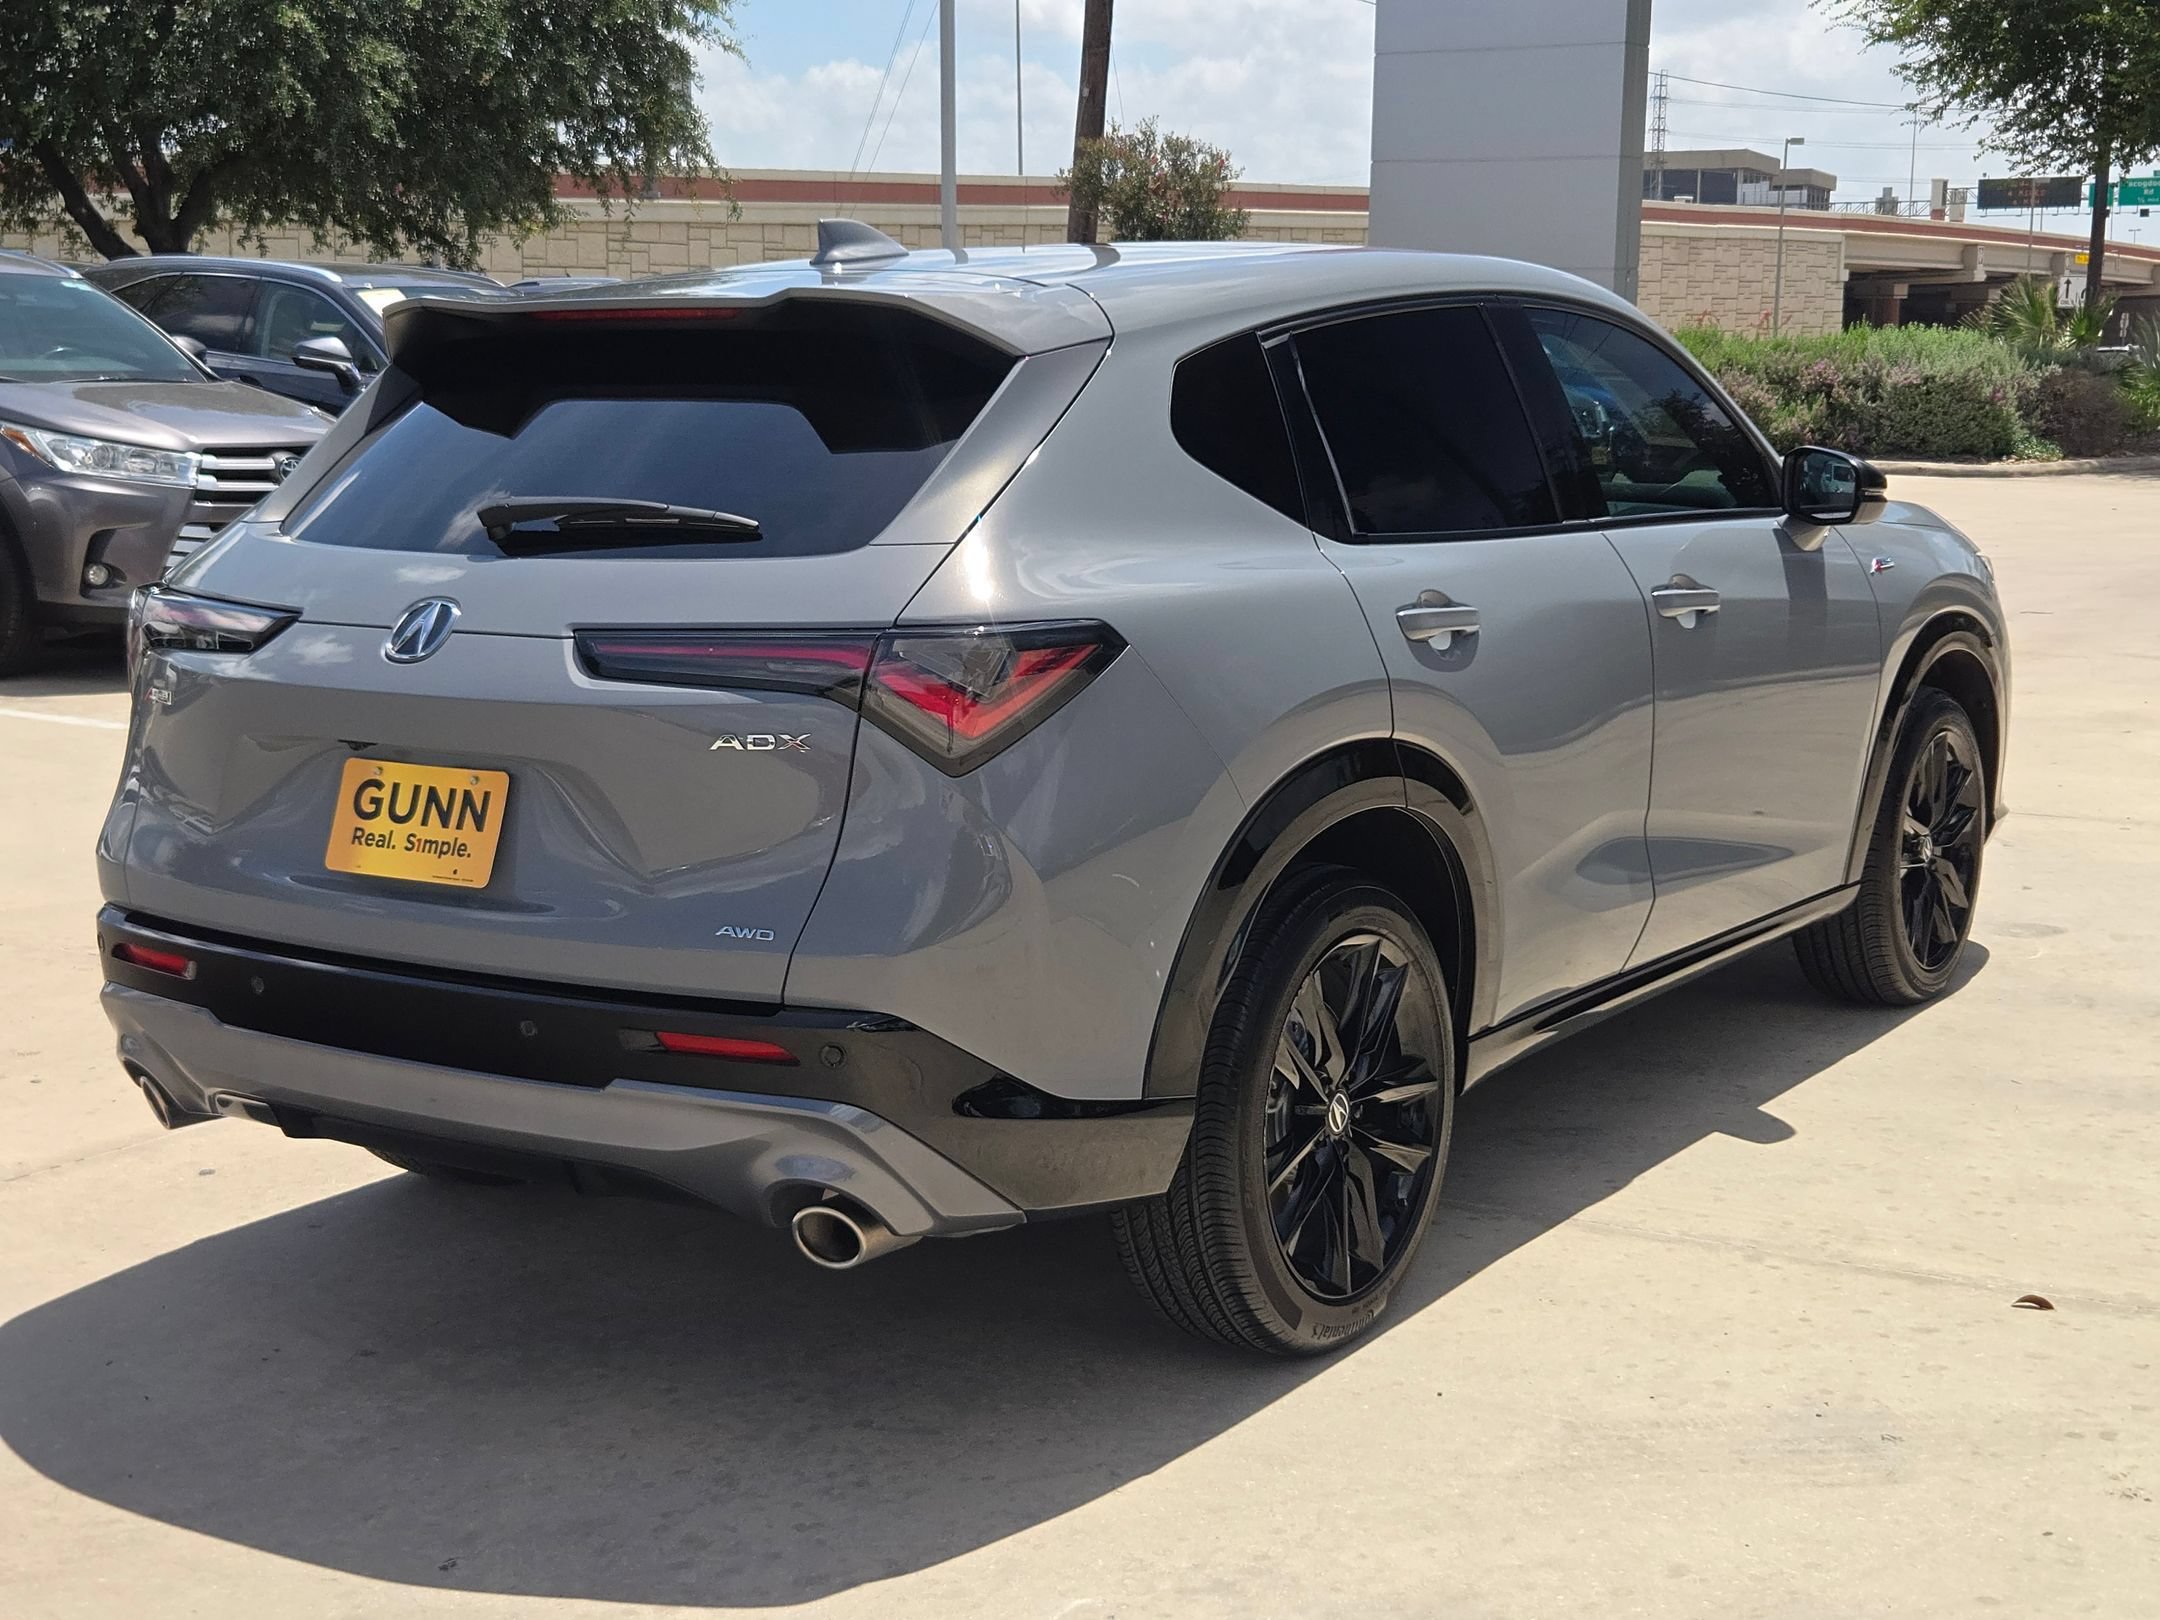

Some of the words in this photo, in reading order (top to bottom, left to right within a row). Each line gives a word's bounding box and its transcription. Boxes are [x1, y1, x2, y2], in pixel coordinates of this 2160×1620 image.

[709, 733, 812, 752] ADX
[353, 778, 491, 833] GUNN
[351, 827, 396, 850] Real.
[715, 926, 775, 941] AWD
